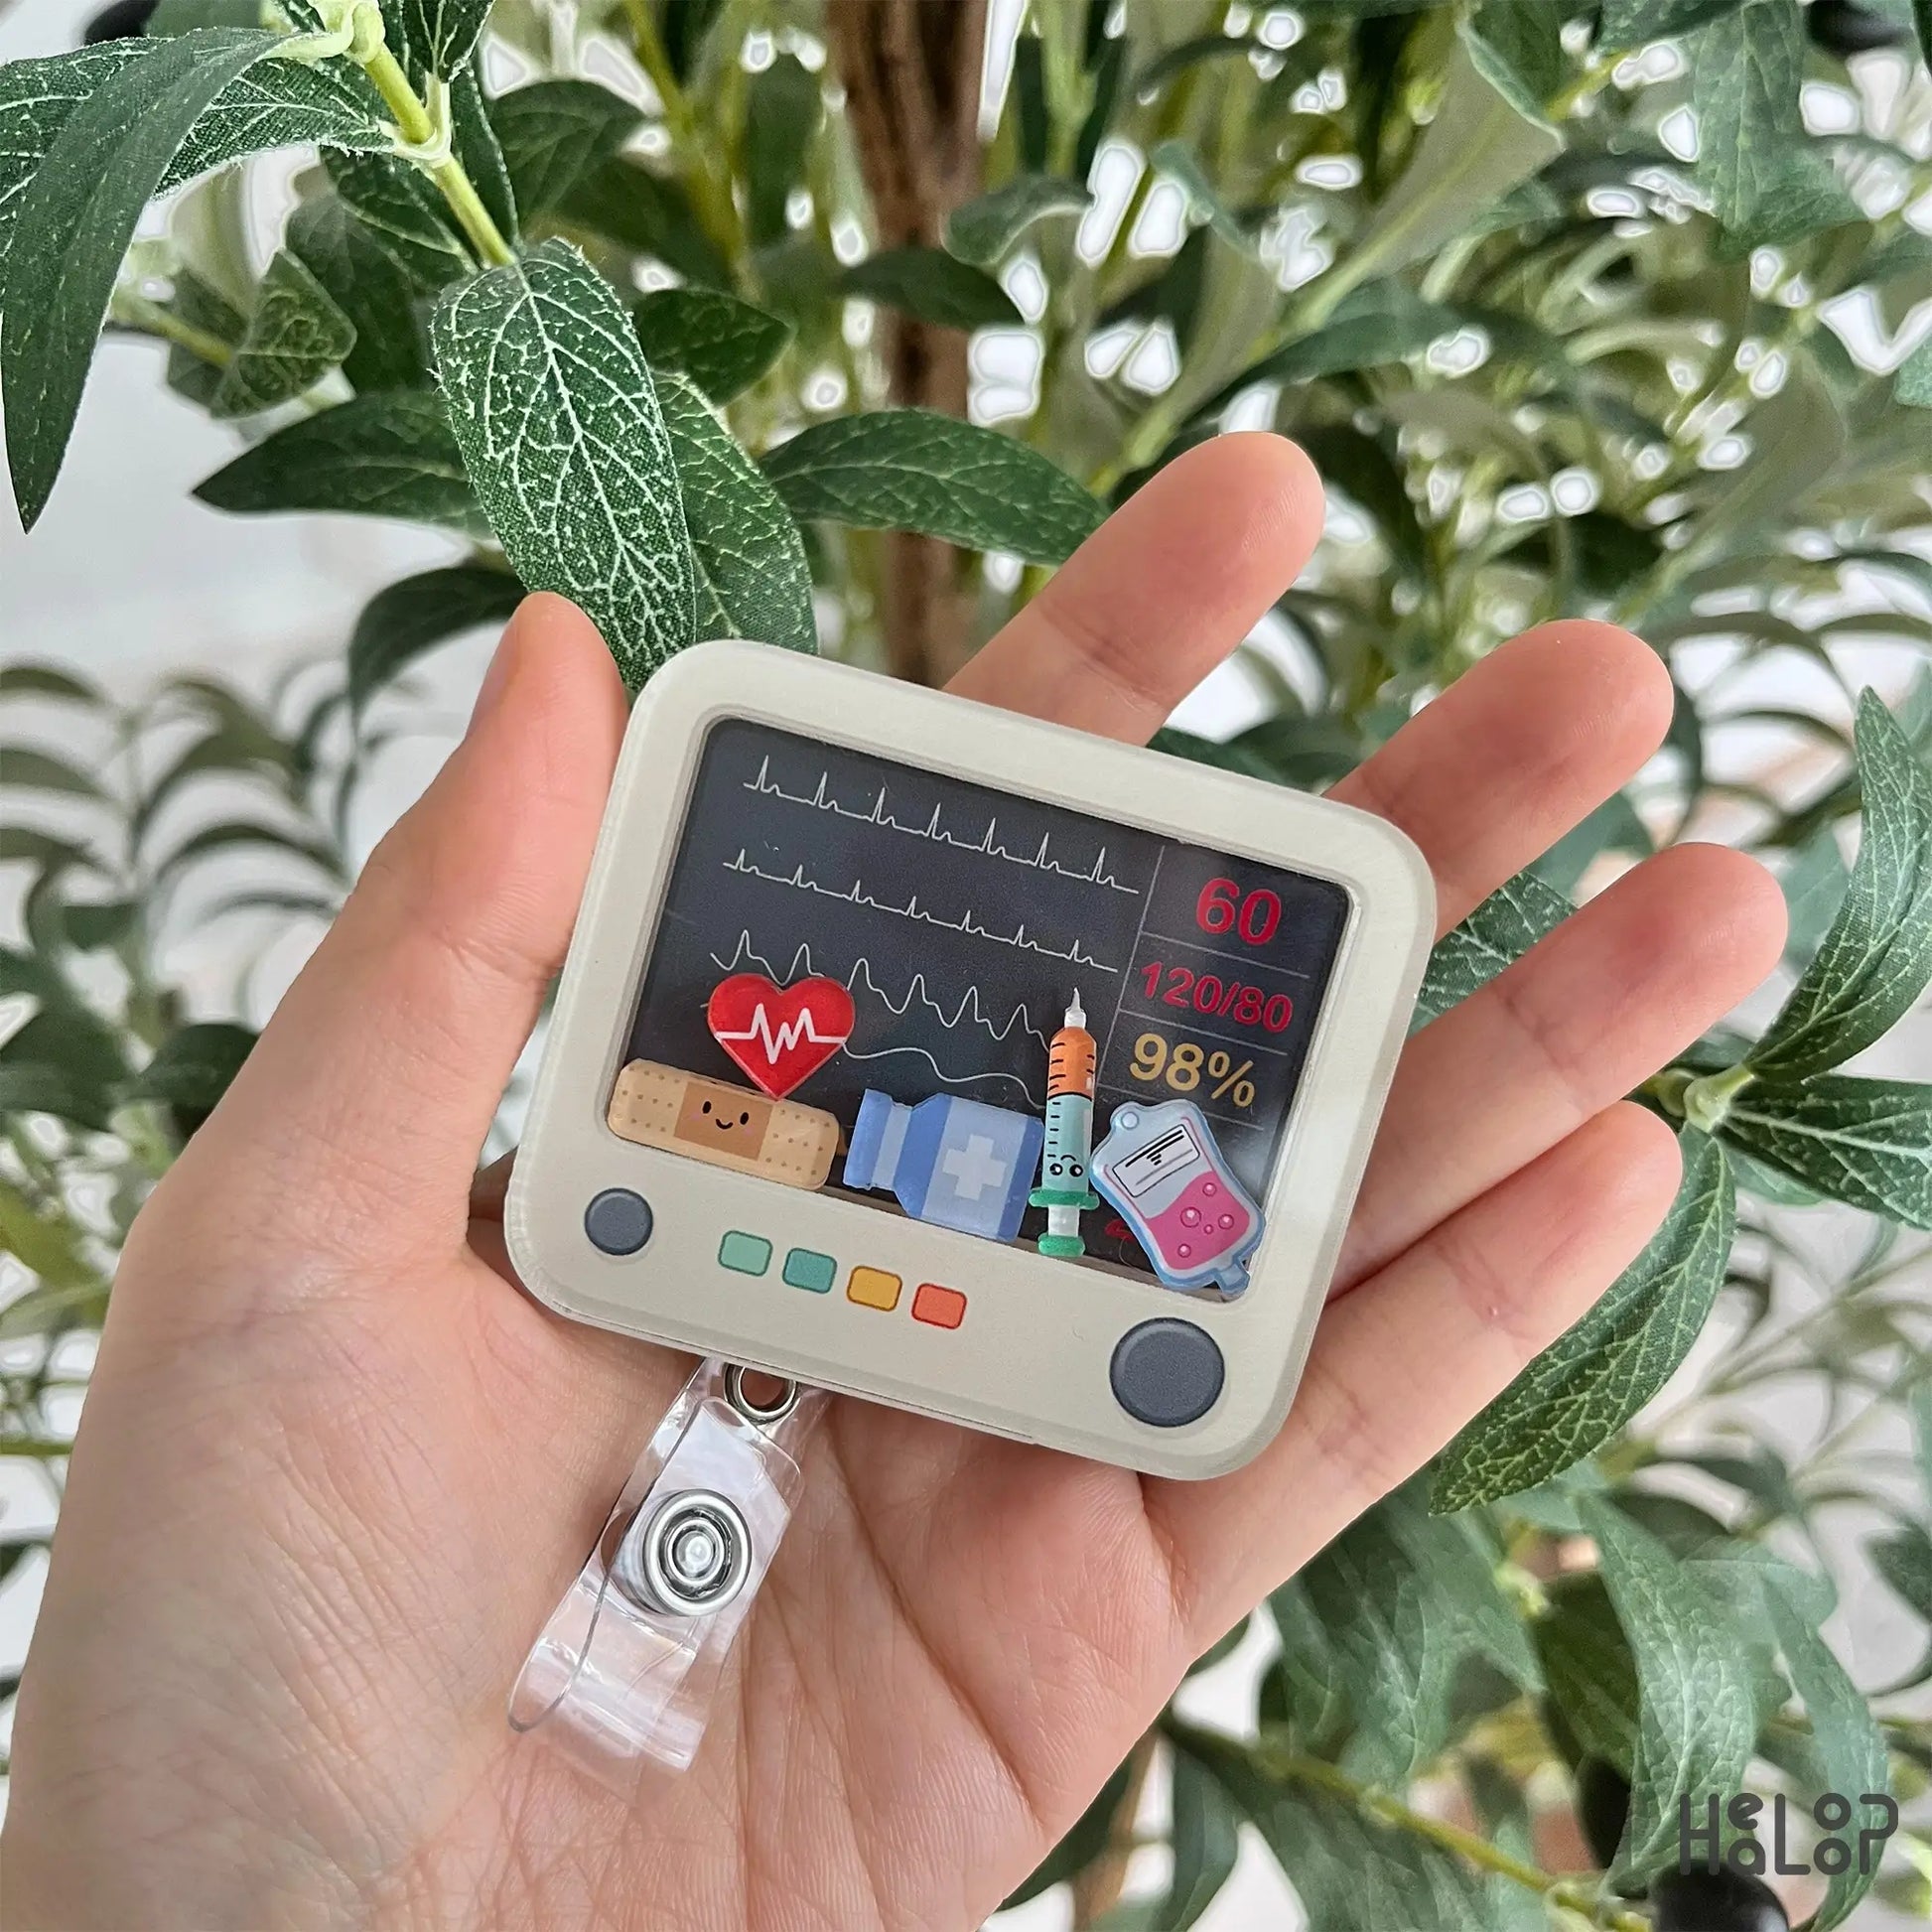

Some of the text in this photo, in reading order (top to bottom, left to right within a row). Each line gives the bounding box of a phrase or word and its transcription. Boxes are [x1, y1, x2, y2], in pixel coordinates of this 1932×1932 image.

[1196, 878, 1282, 945] 60
[1141, 961, 1293, 1033] 120/80
[1129, 1033, 1256, 1108] 98%
